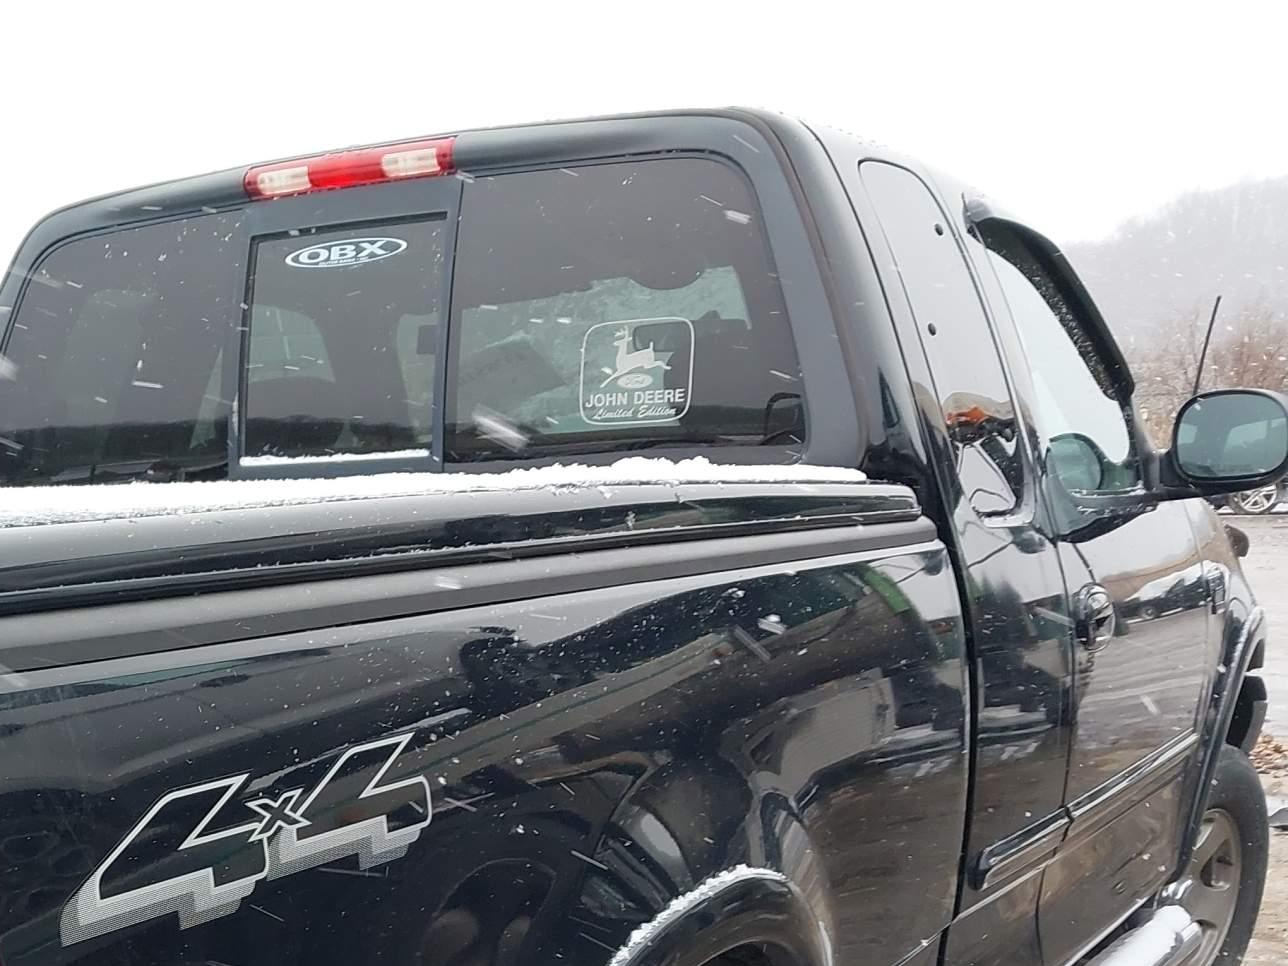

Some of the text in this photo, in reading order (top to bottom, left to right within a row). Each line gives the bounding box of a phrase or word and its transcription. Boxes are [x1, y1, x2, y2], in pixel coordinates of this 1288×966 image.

[299, 240, 389, 263] OBX
[585, 388, 686, 408] JOHN DEERE
[592, 404, 677, 420] Limited Edition
